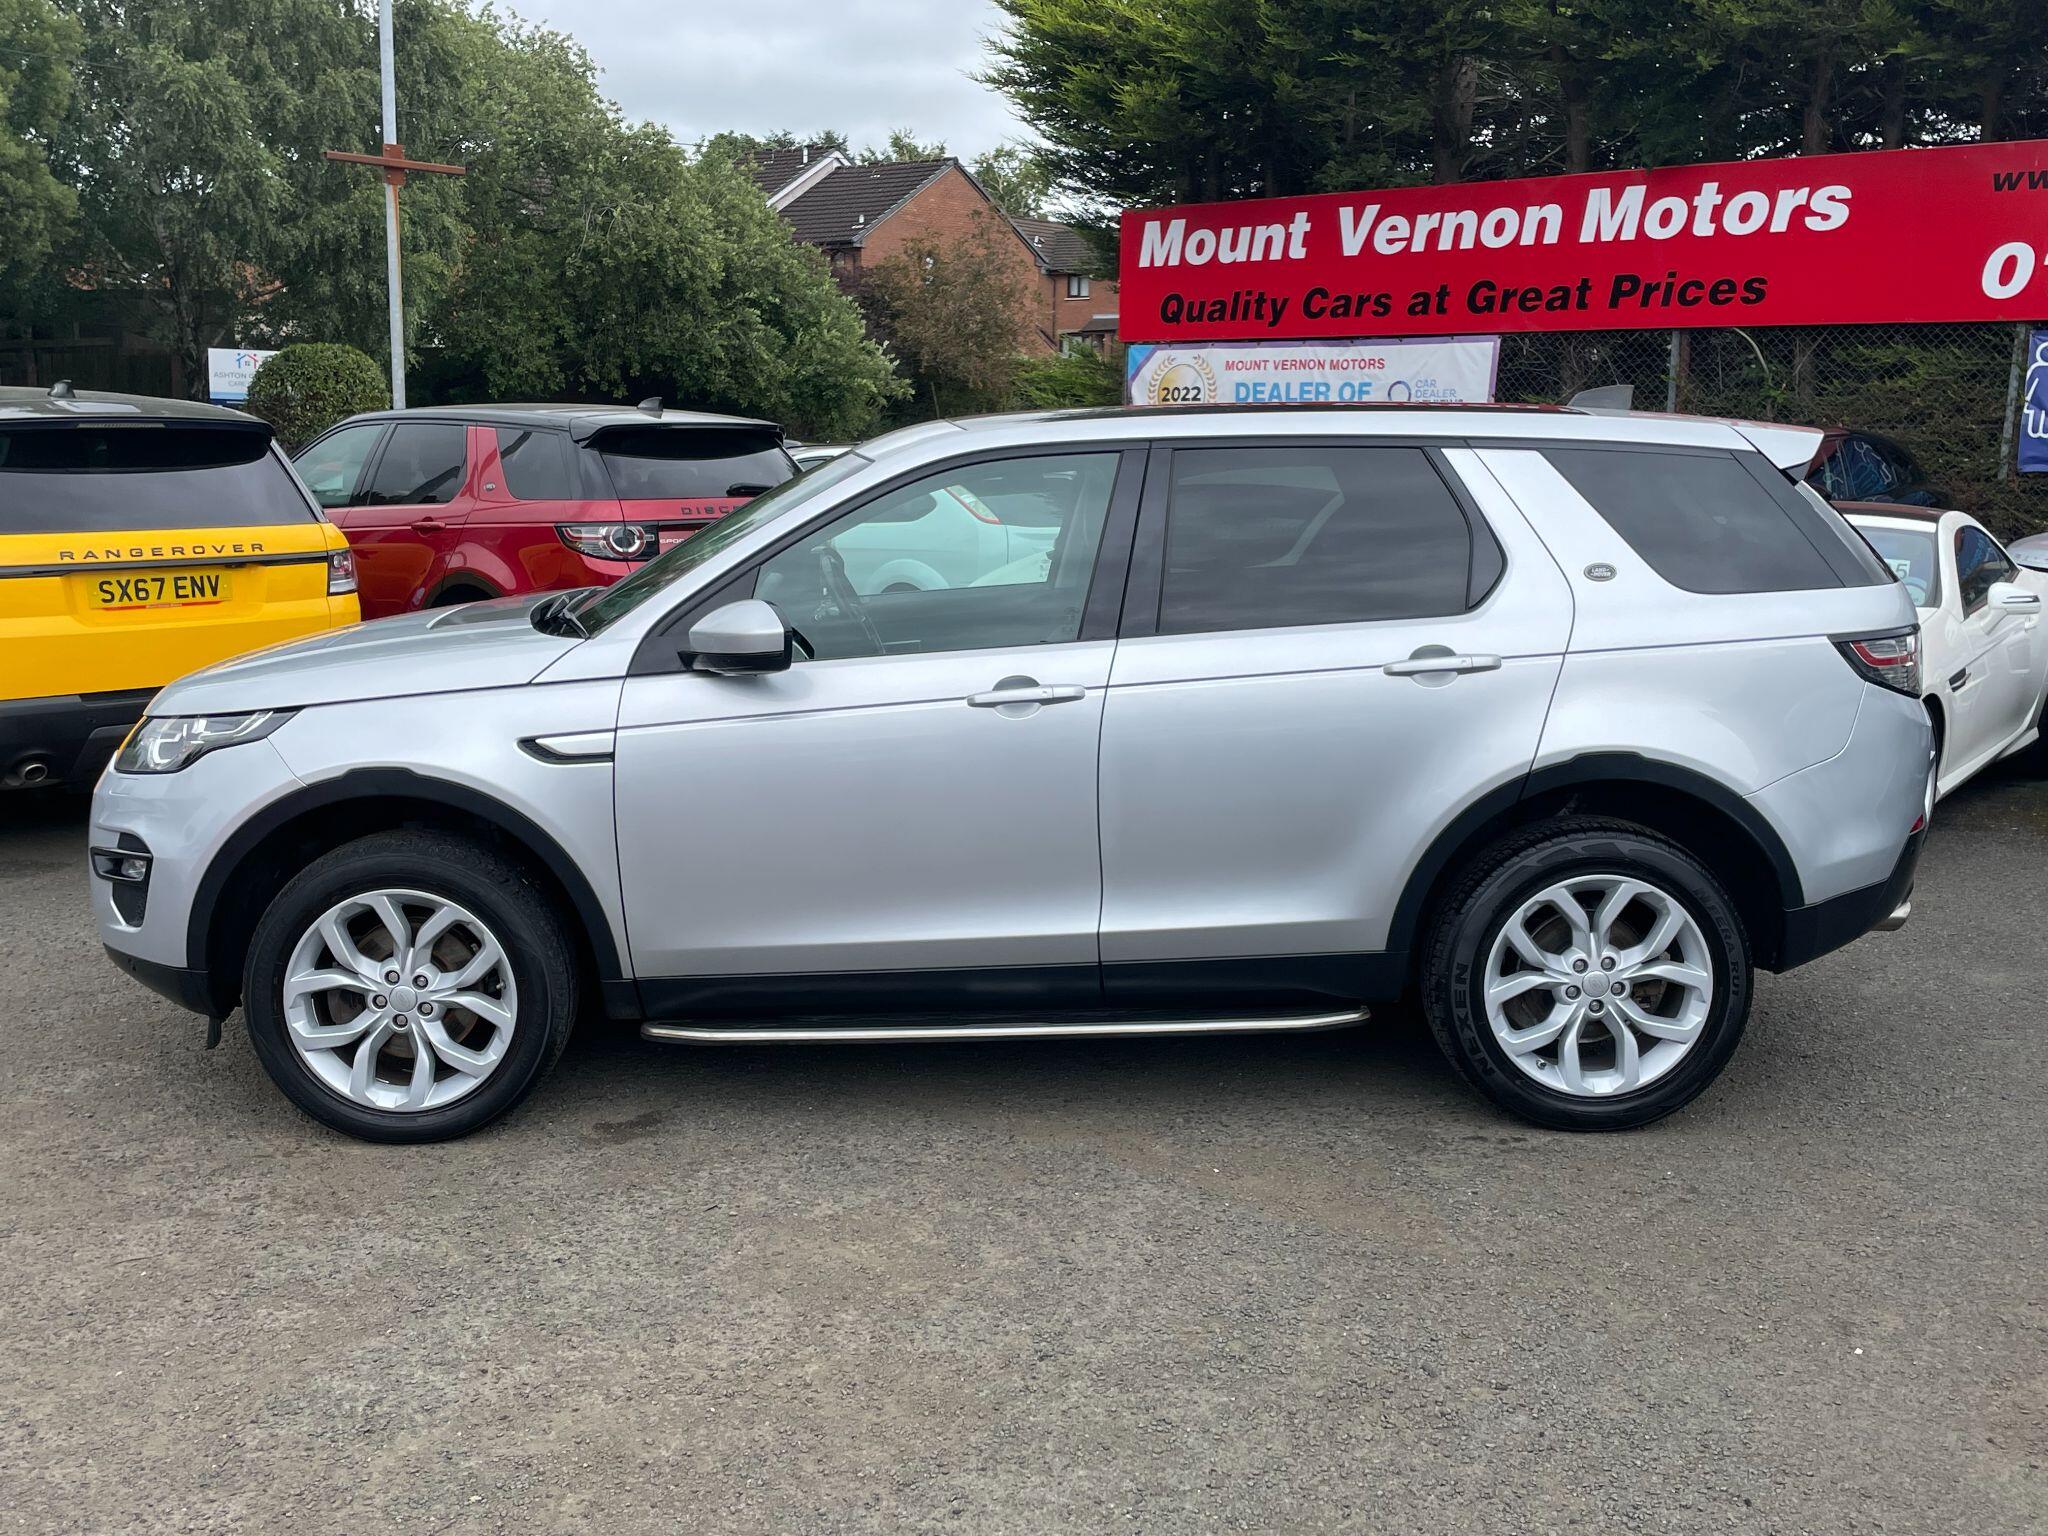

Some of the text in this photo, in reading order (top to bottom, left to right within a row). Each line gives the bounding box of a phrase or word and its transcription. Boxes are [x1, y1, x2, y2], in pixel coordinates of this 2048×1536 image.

[1138, 181, 1853, 268] Mount Vernon Motors
[1982, 241, 2048, 299] 0
[1160, 271, 1768, 328] Quality Cars at Great Prices
[1225, 358, 1385, 372] MOUNT VERNON MOTORS
[213, 371, 247, 380] ASHTON
[1415, 379, 1437, 388] CAR
[1161, 386, 1201, 402] 2022
[1235, 382, 1373, 402] DEALER OF
[1415, 389, 1457, 399] DEALER
[98, 574, 220, 604] SX67 ENV
[1454, 962, 1498, 1078] NEXEN
